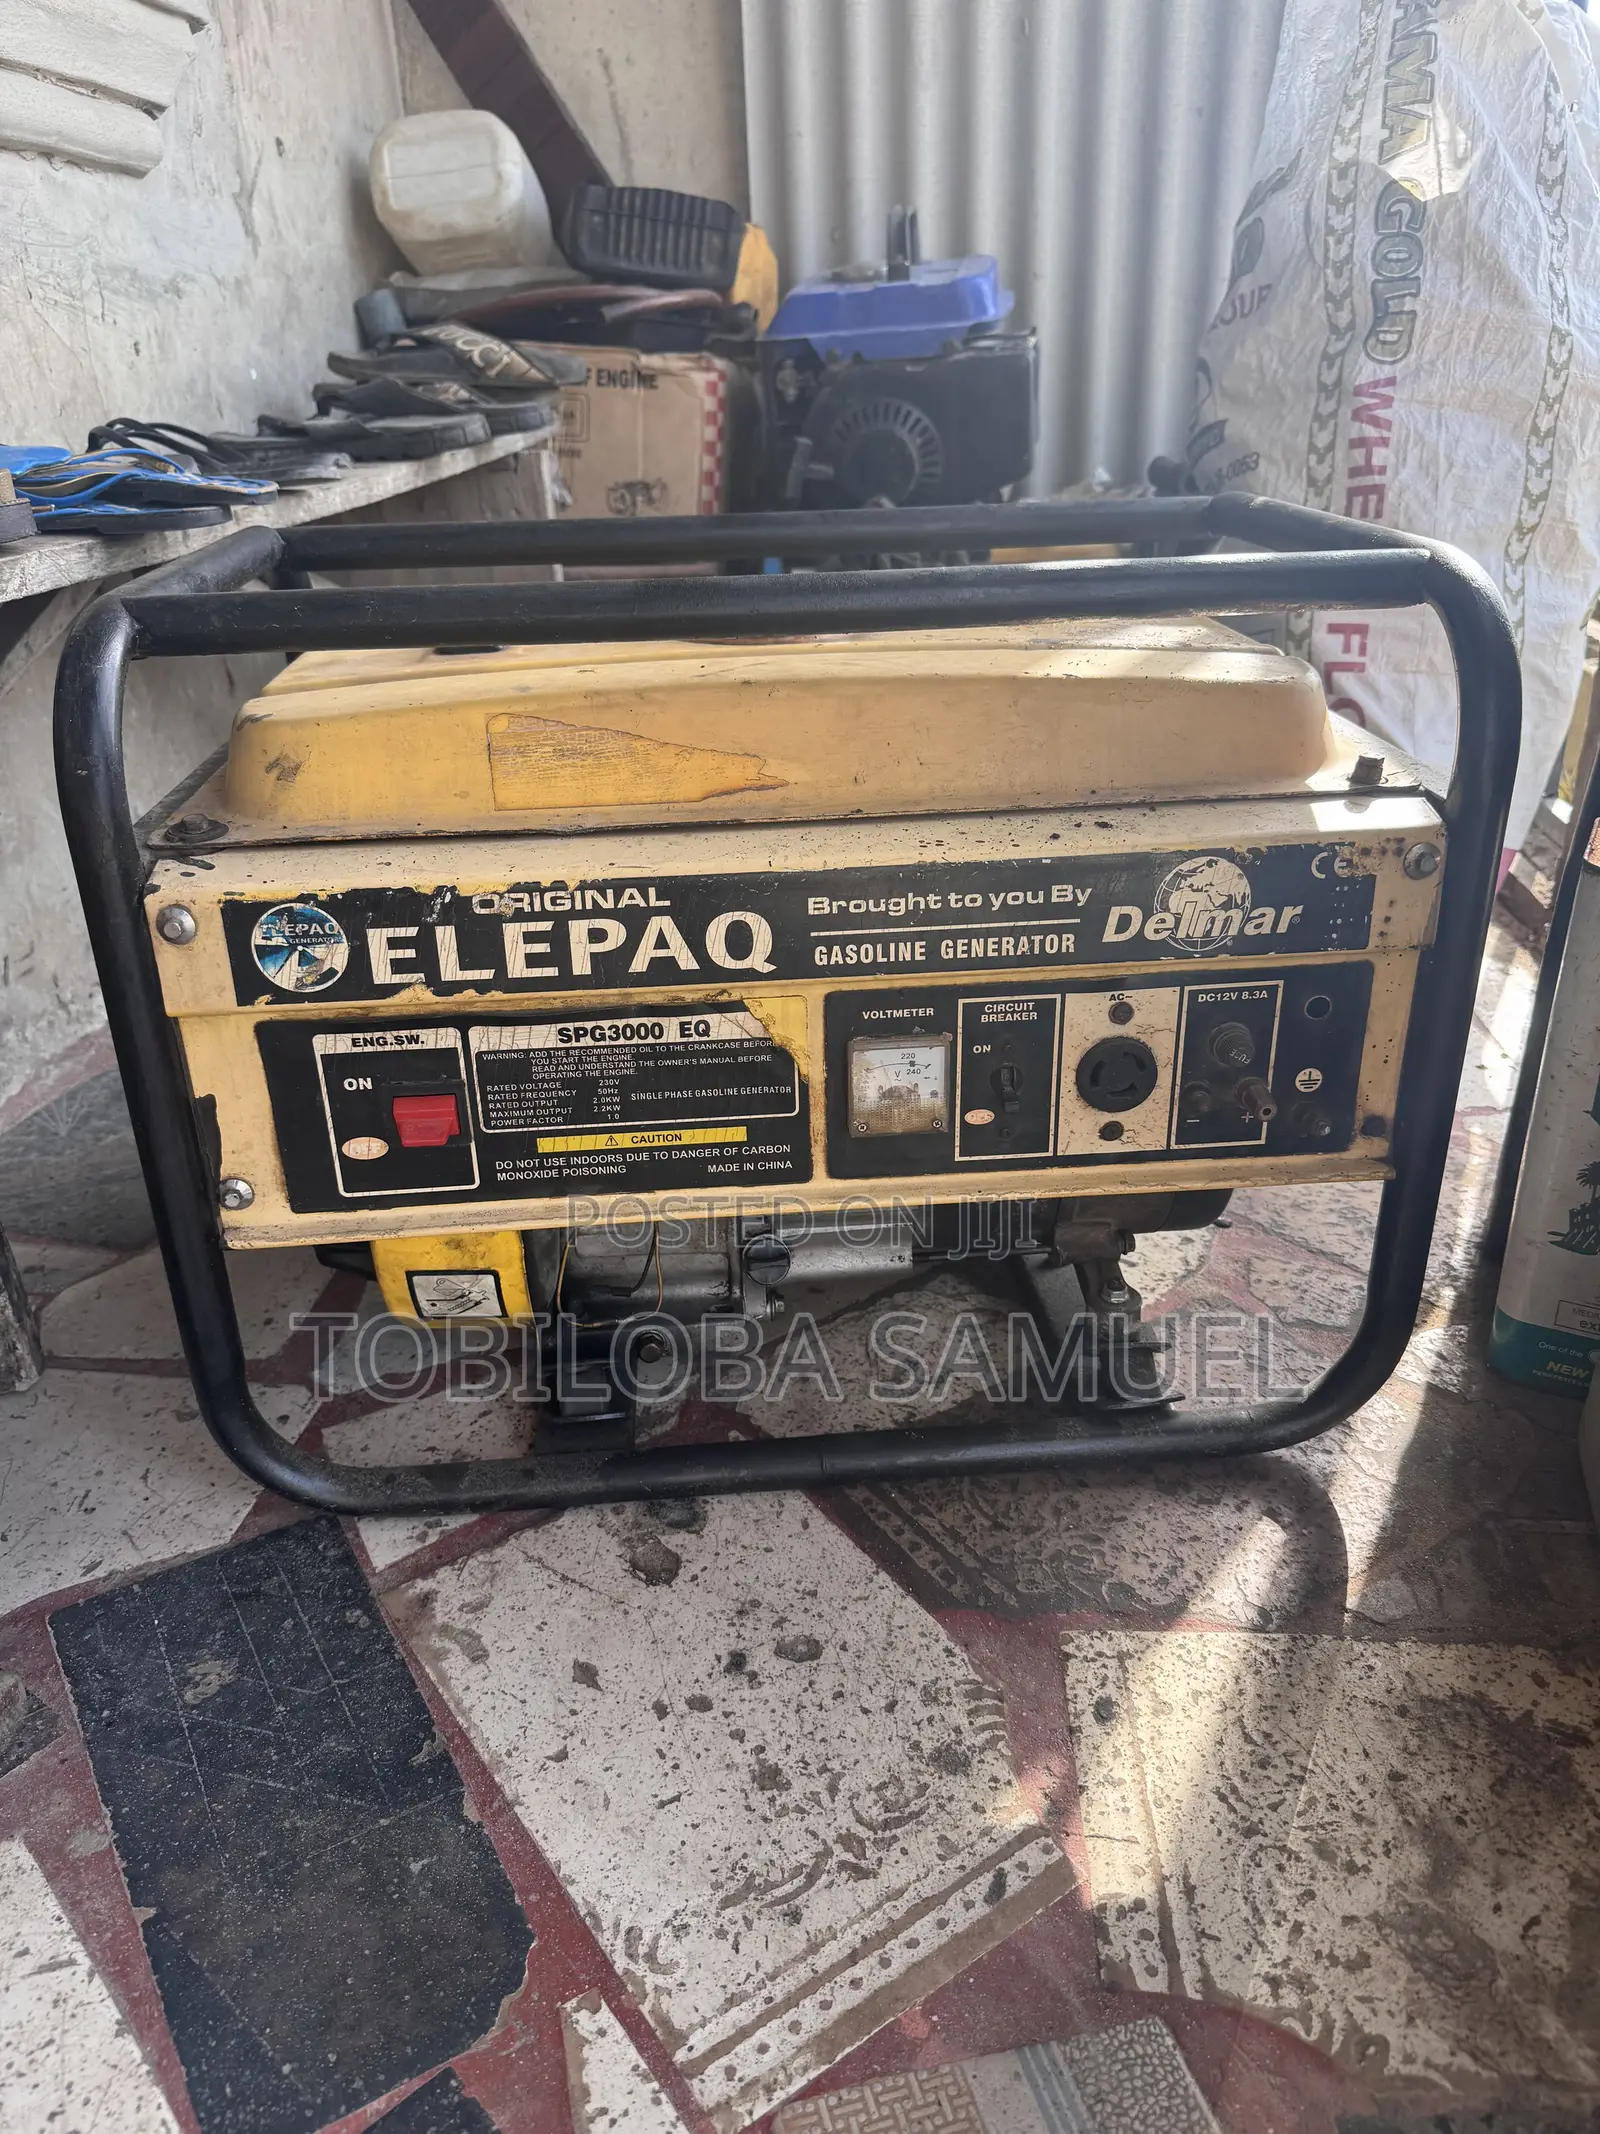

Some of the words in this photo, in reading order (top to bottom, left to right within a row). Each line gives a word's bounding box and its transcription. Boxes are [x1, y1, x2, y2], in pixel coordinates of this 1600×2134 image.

[1363, 176, 1428, 365] GOLD
[596, 367, 659, 390] ENGINE
[1345, 375, 1397, 520] WHE
[472, 887, 671, 916] ORIGINAL
[807, 892, 942, 917] Brought
[949, 891, 983, 909] to
[988, 887, 1045, 911] you
[1051, 884, 1093, 907] By
[1102, 900, 1303, 943] Delmar
[366, 911, 778, 985] ELEPAQ
[814, 940, 927, 966] GASOLINE
[940, 933, 1076, 960] GENERATOR
[1197, 991, 1238, 1003] DC12V
[1241, 990, 1268, 1000] 8.3A
[862, 1007, 935, 1020] VOLTMETER
[984, 1002, 1035, 1013] CIRCUIT
[980, 1012, 1038, 1023] BREAKER
[558, 1022, 664, 1043] SPG3000
[679, 1020, 711, 1038] EQ
[351, 1034, 425, 1048] ENG.SW.
[482, 1052, 527, 1060] WARNING:
[569, 1046, 636, 1056] RECOMMENDED
[688, 1041, 740, 1051] CRANKCASE
[973, 1044, 992, 1054] ON
[1229, 1048, 1250, 1064] FUSE
[531, 1057, 549, 1065] YOU
[552, 1056, 579, 1064] START
[581, 1055, 598, 1063] THE
[601, 1054, 635, 1062] ENGINE.
[532, 1065, 556, 1073] READ
[558, 1064, 577, 1072] AND
[579, 1061, 636, 1070] UNDERSTAND
[658, 1058, 697, 1067] OWNER'S
[700, 1056, 736, 1065] MANUAL
[738, 1054, 772, 1063] BEFORE
[532, 1070, 582, 1080] OPERATING
[585, 1069, 601, 1077] THE
[604, 1068, 638, 1076] ENGINE.
[343, 1077, 373, 1091] ON
[487, 1083, 517, 1092] RATED
[519, 1081, 562, 1091] VOLTAGE
[488, 1092, 518, 1100] RATED
[521, 1089, 577, 1099] FREQUENCY
[631, 1092, 663, 1101] SINGLE
[665, 1090, 693, 1099] PHASE
[695, 1087, 738, 1098] GASOLINE
[740, 1086, 792, 1095] GENERATOR
[489, 1101, 519, 1109] RATED
[522, 1099, 558, 1108] OUTPUT
[593, 1096, 621, 1104] 2.0KW
[490, 1109, 534, 1118] MAXIMUM
[536, 1107, 573, 1116] OUTPUT
[491, 1118, 524, 1127] POWER
[526, 1116, 564, 1125] FACTOR
[631, 1133, 682, 1144] CAUTION
[496, 1160, 513, 1170] DO
[516, 1158, 540, 1169] NOT
[544, 1156, 567, 1167] USE
[570, 1153, 623, 1166] INDOORS
[627, 1151, 650, 1162] DUE
[653, 1150, 668, 1160] TO
[671, 1148, 720, 1159] DANGER
[723, 1146, 738, 1156] OF
[742, 1144, 791, 1155] CARBON
[497, 1169, 560, 1181] MONOXIDE
[563, 1164, 627, 1177] POISONING
[708, 1163, 740, 1173] MADE
[743, 1162, 754, 1171] IN
[757, 1160, 793, 1170] CHINA
[1538, 1341, 1556, 1351] One
[1546, 1361, 1590, 1378] NEW
